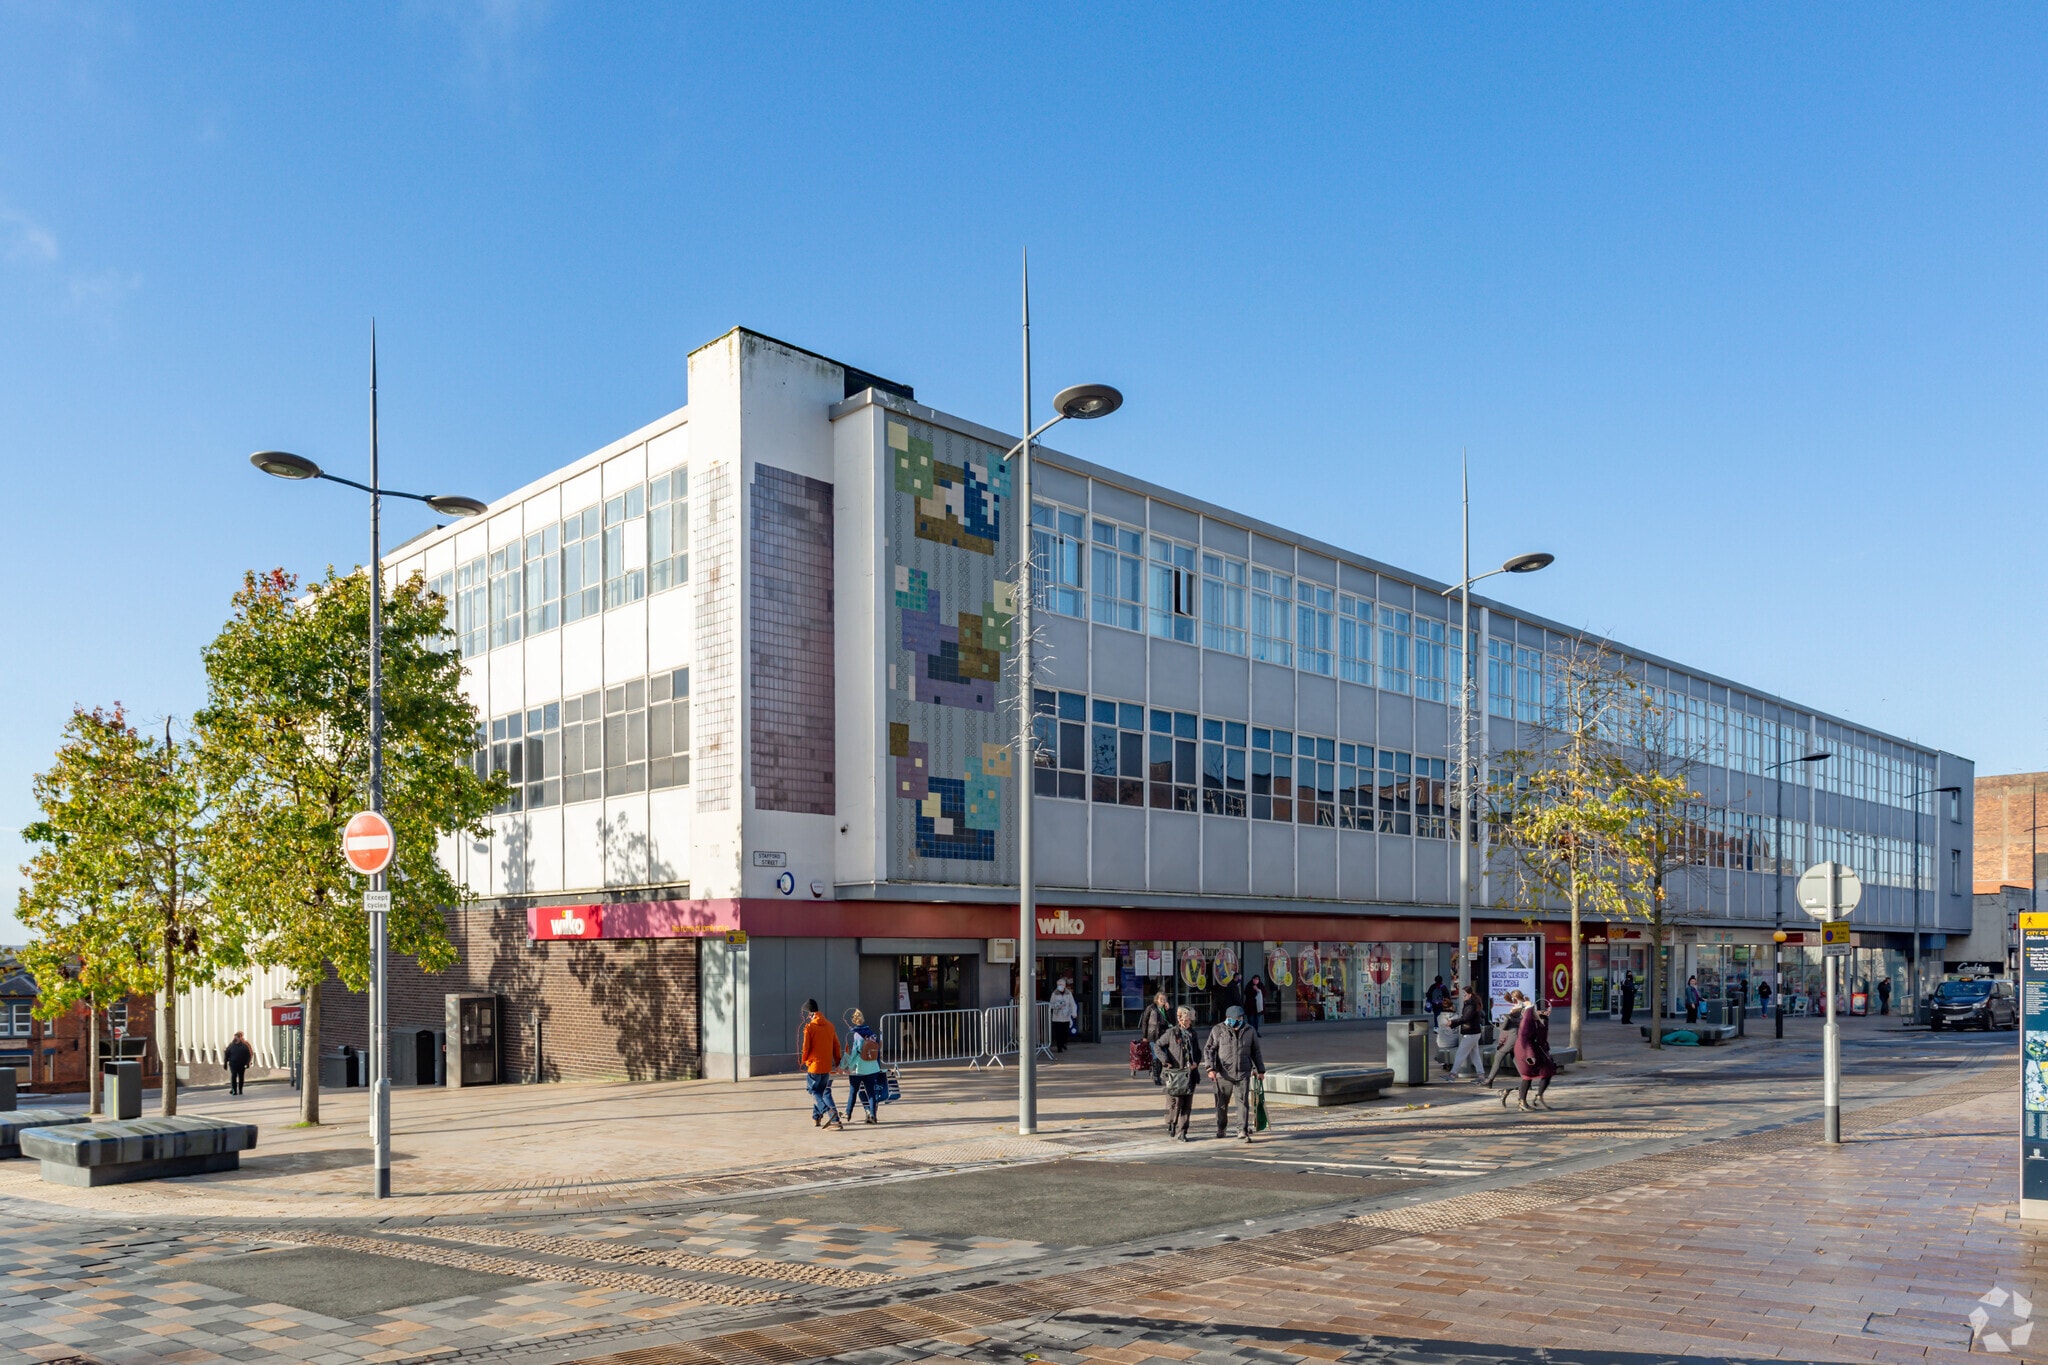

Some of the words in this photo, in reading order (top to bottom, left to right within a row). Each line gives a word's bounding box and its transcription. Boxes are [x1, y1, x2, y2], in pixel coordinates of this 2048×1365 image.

[366, 893, 388, 901] Except
[550, 909, 585, 936] wilko
[1037, 909, 1085, 935] wilko
[1588, 935, 1607, 943] wilko
[1957, 962, 1990, 973] Cookies
[281, 1011, 301, 1021] BUZ
